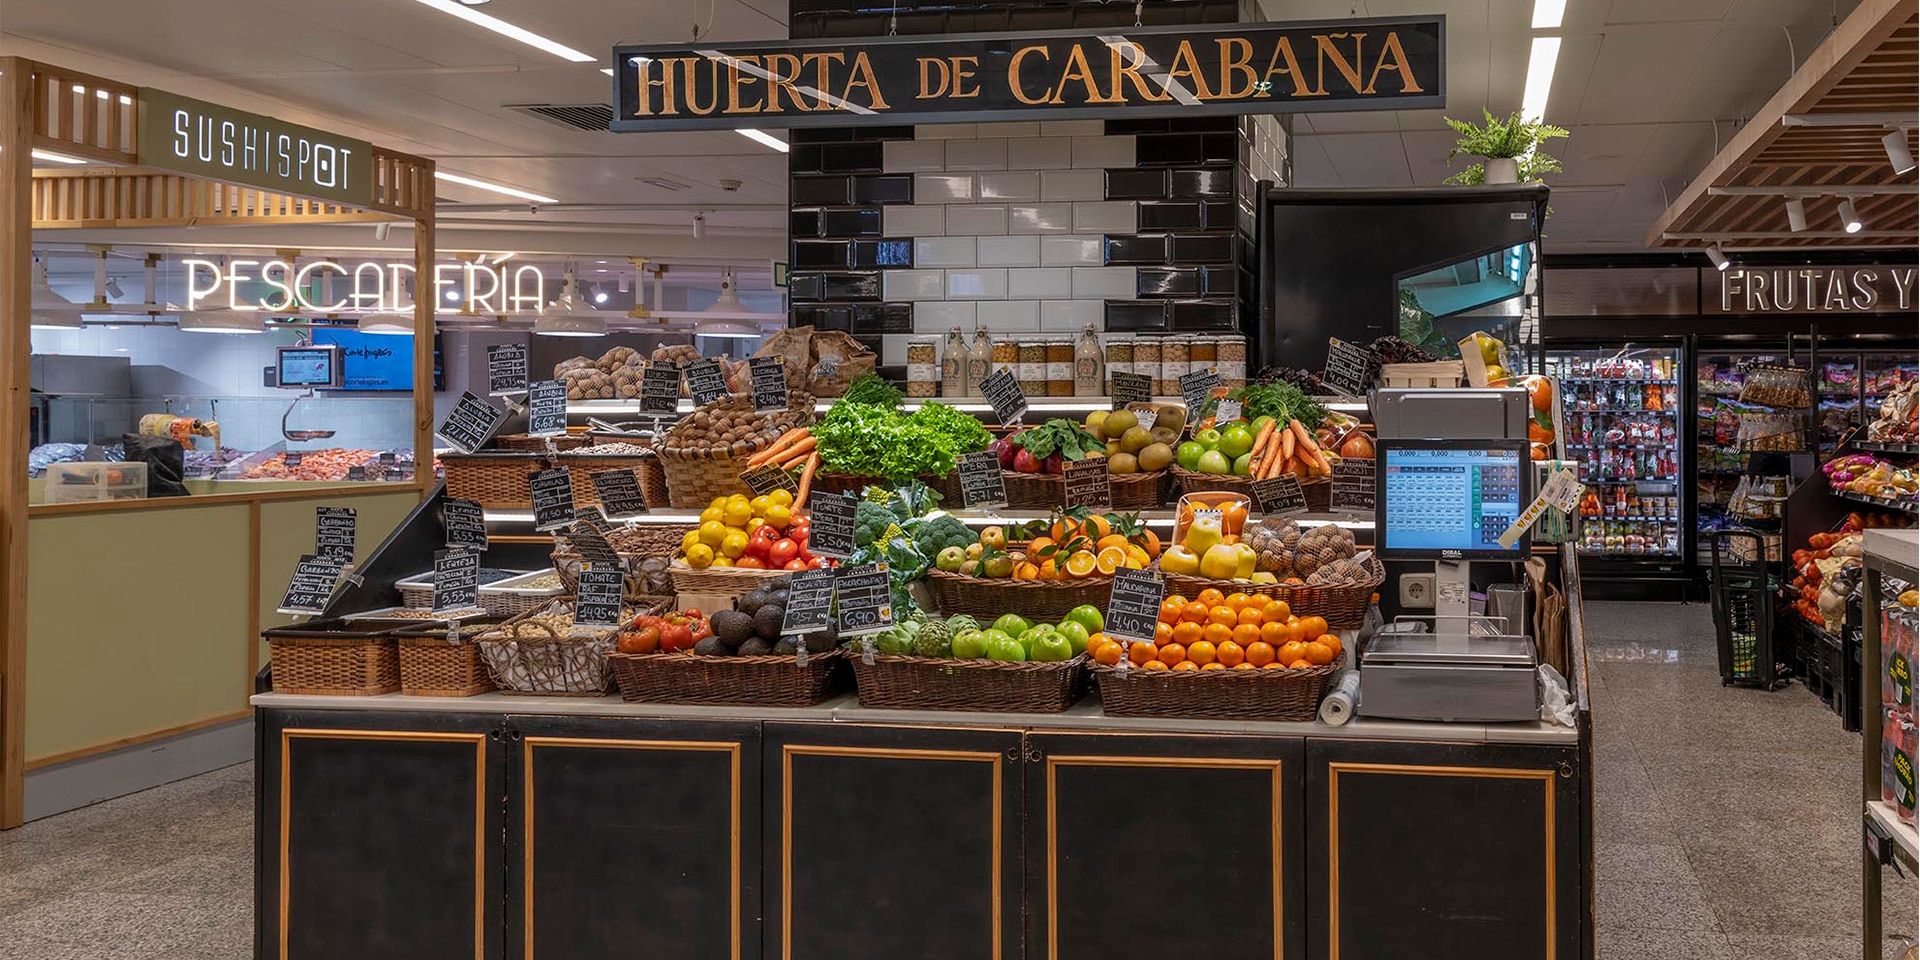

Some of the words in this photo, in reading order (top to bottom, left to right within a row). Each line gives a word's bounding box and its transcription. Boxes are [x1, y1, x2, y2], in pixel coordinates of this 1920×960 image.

[633, 51, 891, 116] HUERTA
[916, 56, 981, 99] DE
[1008, 31, 1426, 105] CARABAÑA
[182, 253, 544, 313] PESCADERÍA
[1722, 269, 1878, 311] FRUTAS
[1891, 269, 1919, 310] Y
[962, 461, 988, 472] PERA
[440, 557, 476, 571] LENTEJA
[582, 572, 617, 583] TOMATE
[581, 585, 599, 594] RAF
[441, 590, 465, 604] 5,53
